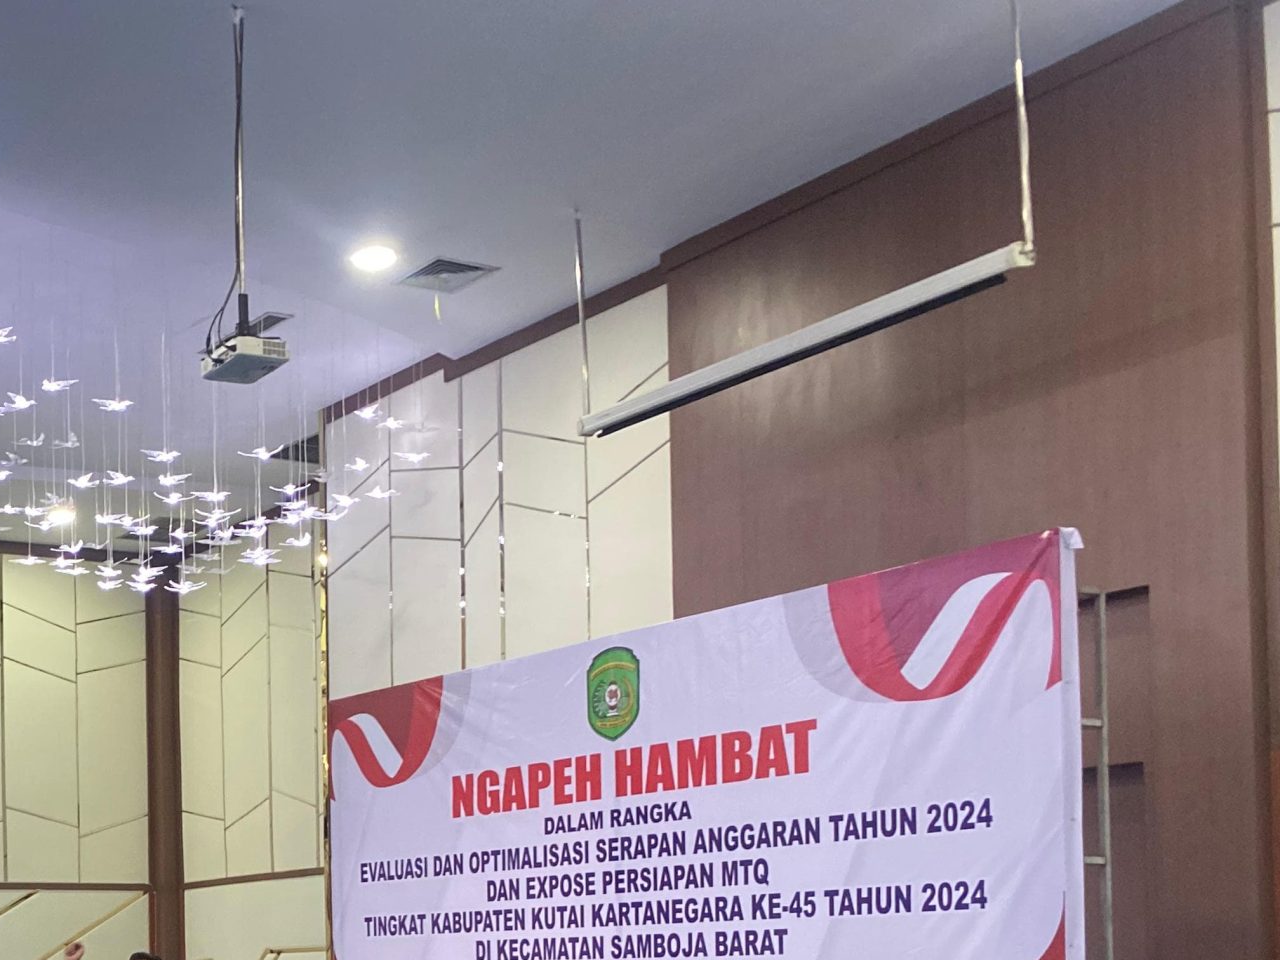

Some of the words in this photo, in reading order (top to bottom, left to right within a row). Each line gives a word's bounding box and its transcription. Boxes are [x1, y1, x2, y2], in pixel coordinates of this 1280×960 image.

[451, 753, 602, 819] NGAPEH
[613, 719, 818, 798] HAMBAT
[360, 856, 428, 883] EVALUASI
[433, 853, 464, 877] DAN
[469, 841, 590, 874] OPTIMALISASI
[596, 831, 686, 864] SERAPAN
[693, 817, 821, 855] ANGGARAN
[828, 806, 918, 842] TAHUN
[926, 798, 993, 834] 2024
[544, 811, 604, 835] DALAM
[610, 801, 692, 828] RANGKA
[487, 878, 520, 902] DAN
[526, 871, 596, 900] EXPOSE
[602, 862, 714, 895] PERSIAPAN
[721, 858, 769, 887] MTQ
[364, 913, 426, 937] TINGKAT
[431, 908, 526, 935] KABUPATEN
[531, 904, 585, 930] KUTAI
[591, 895, 744, 928] KARTANEGARA
[751, 890, 817, 920] KE-45
[824, 884, 912, 917] TAHUN
[921, 879, 988, 913] 2024
[610, 931, 708, 960] SAMBOJA
[715, 929, 788, 957] BARAT
